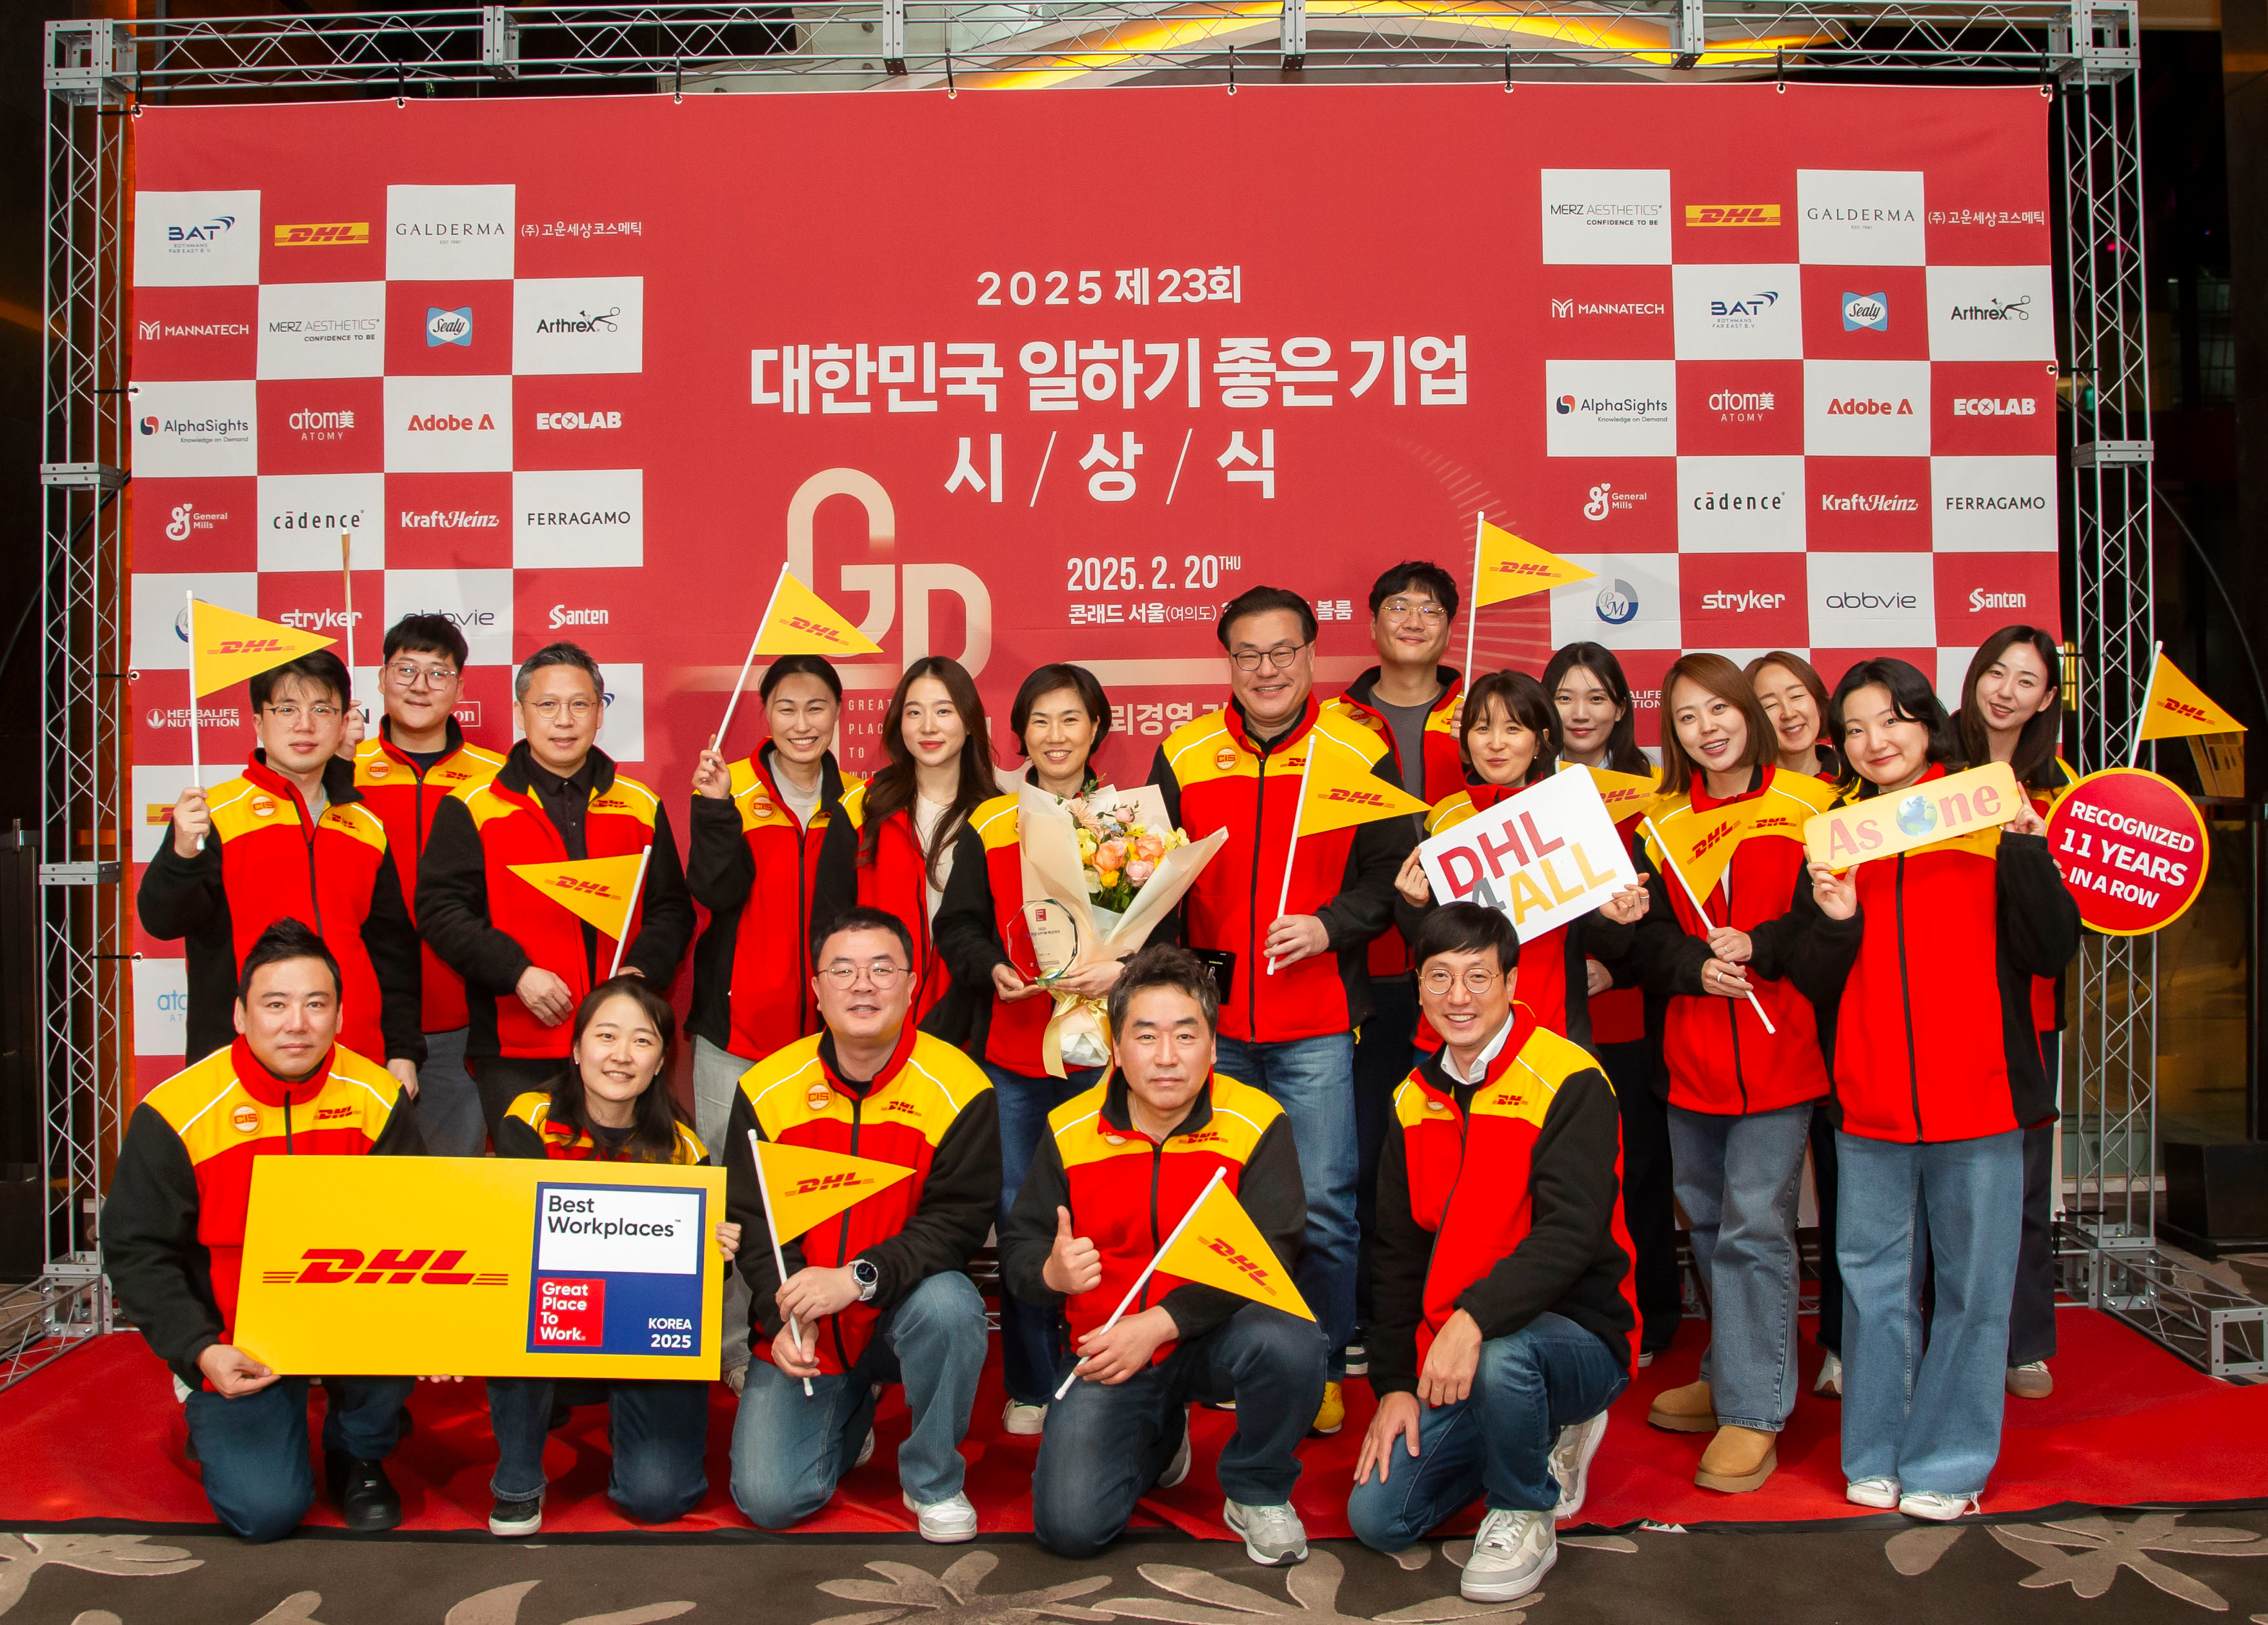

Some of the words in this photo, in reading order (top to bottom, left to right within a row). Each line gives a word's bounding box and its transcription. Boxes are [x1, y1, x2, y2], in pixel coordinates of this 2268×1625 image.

[1550, 205, 1584, 216] MERZ
[1586, 205, 1659, 216] AESTHETICS
[1698, 208, 1770, 223] DHL
[1807, 208, 1916, 222] GALDERMA
[1928, 211, 1946, 225] (주)
[1948, 209, 2045, 227] 고운세상코스메틱
[168, 226, 221, 241] BAT
[288, 226, 354, 243] DHL
[396, 223, 505, 236] GALDERMA
[521, 223, 539, 238] (주)
[541, 221, 642, 239] 고운세상코스메틱
[976, 270, 1103, 306] 2025
[1578, 304, 1665, 314] MANNATECH
[1711, 301, 1765, 316] BAT
[1849, 303, 1881, 321] Sealy
[1951, 306, 2009, 321] Arthrex
[165, 324, 249, 336] MANNATECH
[269, 321, 302, 332] MERZ
[304, 319, 376, 332] AESTHETICS
[432, 318, 465, 336] Sealy
[536, 319, 596, 334] Arthrex
[751, 341, 1004, 415] 대한민국
[1019, 337, 1200, 412] 일하기
[1212, 336, 1340, 409] 좋은
[1350, 334, 1467, 407] 기업
[1580, 398, 1668, 414] AlphaSights
[1827, 398, 1892, 415] Adobe
[1953, 398, 2036, 416] ECOLAB
[407, 414, 473, 431] Adobe
[536, 411, 622, 430] ECOLAB
[1720, 413, 1764, 422] ATOMY
[164, 418, 249, 435] AlphaSights
[301, 431, 344, 441] ATOMY
[1612, 492, 1647, 501] General
[1946, 496, 2046, 510] FERRAGAMO
[1612, 501, 1632, 509] Mills
[194, 512, 228, 521] General
[527, 511, 631, 526] FERRAGAMO
[1067, 556, 1145, 591] 2025.
[1151, 556, 1176, 590] 2.
[1497, 561, 1552, 577] DHL
[1701, 590, 1786, 612] stryker
[1826, 592, 1917, 609] abbvie
[1969, 588, 2027, 612] Santen
[548, 605, 609, 629] Santen
[1069, 603, 1125, 625] 콘래드
[1316, 600, 1353, 621] 볼룸
[280, 608, 363, 631] stryker
[789, 616, 842, 643] DHL
[219, 639, 284, 654] DHL
[848, 699, 892, 711] GREAT
[2163, 698, 2208, 722] DHL
[1110, 702, 1194, 736] 뢰경영
[848, 723, 884, 735] PLAC
[848, 747, 865, 758] TO
[1217, 754, 1236, 762] CIS
[1328, 789, 1385, 807] DHL
[252, 802, 274, 811] CIS
[754, 802, 772, 811] CIS
[1755, 817, 1790, 829] DHL
[2070, 800, 2195, 853] RECOGNIZED
[1692, 820, 1734, 860] DHL
[1830, 818, 1883, 861] As
[1437, 811, 1565, 900] DHL
[2060, 828, 2092, 858] 11
[2100, 839, 2189, 887] YEARS
[555, 876, 612, 898] DHL
[2069, 867, 2092, 888] IN
[2091, 877, 2107, 894] A
[2109, 881, 2160, 909] ROW
[808, 1092, 829, 1102] CIS
[1498, 1095, 1523, 1105] DH
[317, 1105, 354, 1120] DHL
[888, 1101, 915, 1115] DHL
[234, 1113, 257, 1124] CIS
[1187, 1131, 1221, 1144] DHL
[796, 1172, 862, 1194] DHL
[548, 1195, 595, 1213] Best
[294, 1249, 476, 1285] DHL
[1207, 1237, 1271, 1287] DHL
[541, 1282, 588, 1297] Great
[542, 1297, 587, 1311] Place
[540, 1311, 558, 1325] To
[648, 1318, 692, 1331] KOREA
[650, 1334, 692, 1349] 2025
